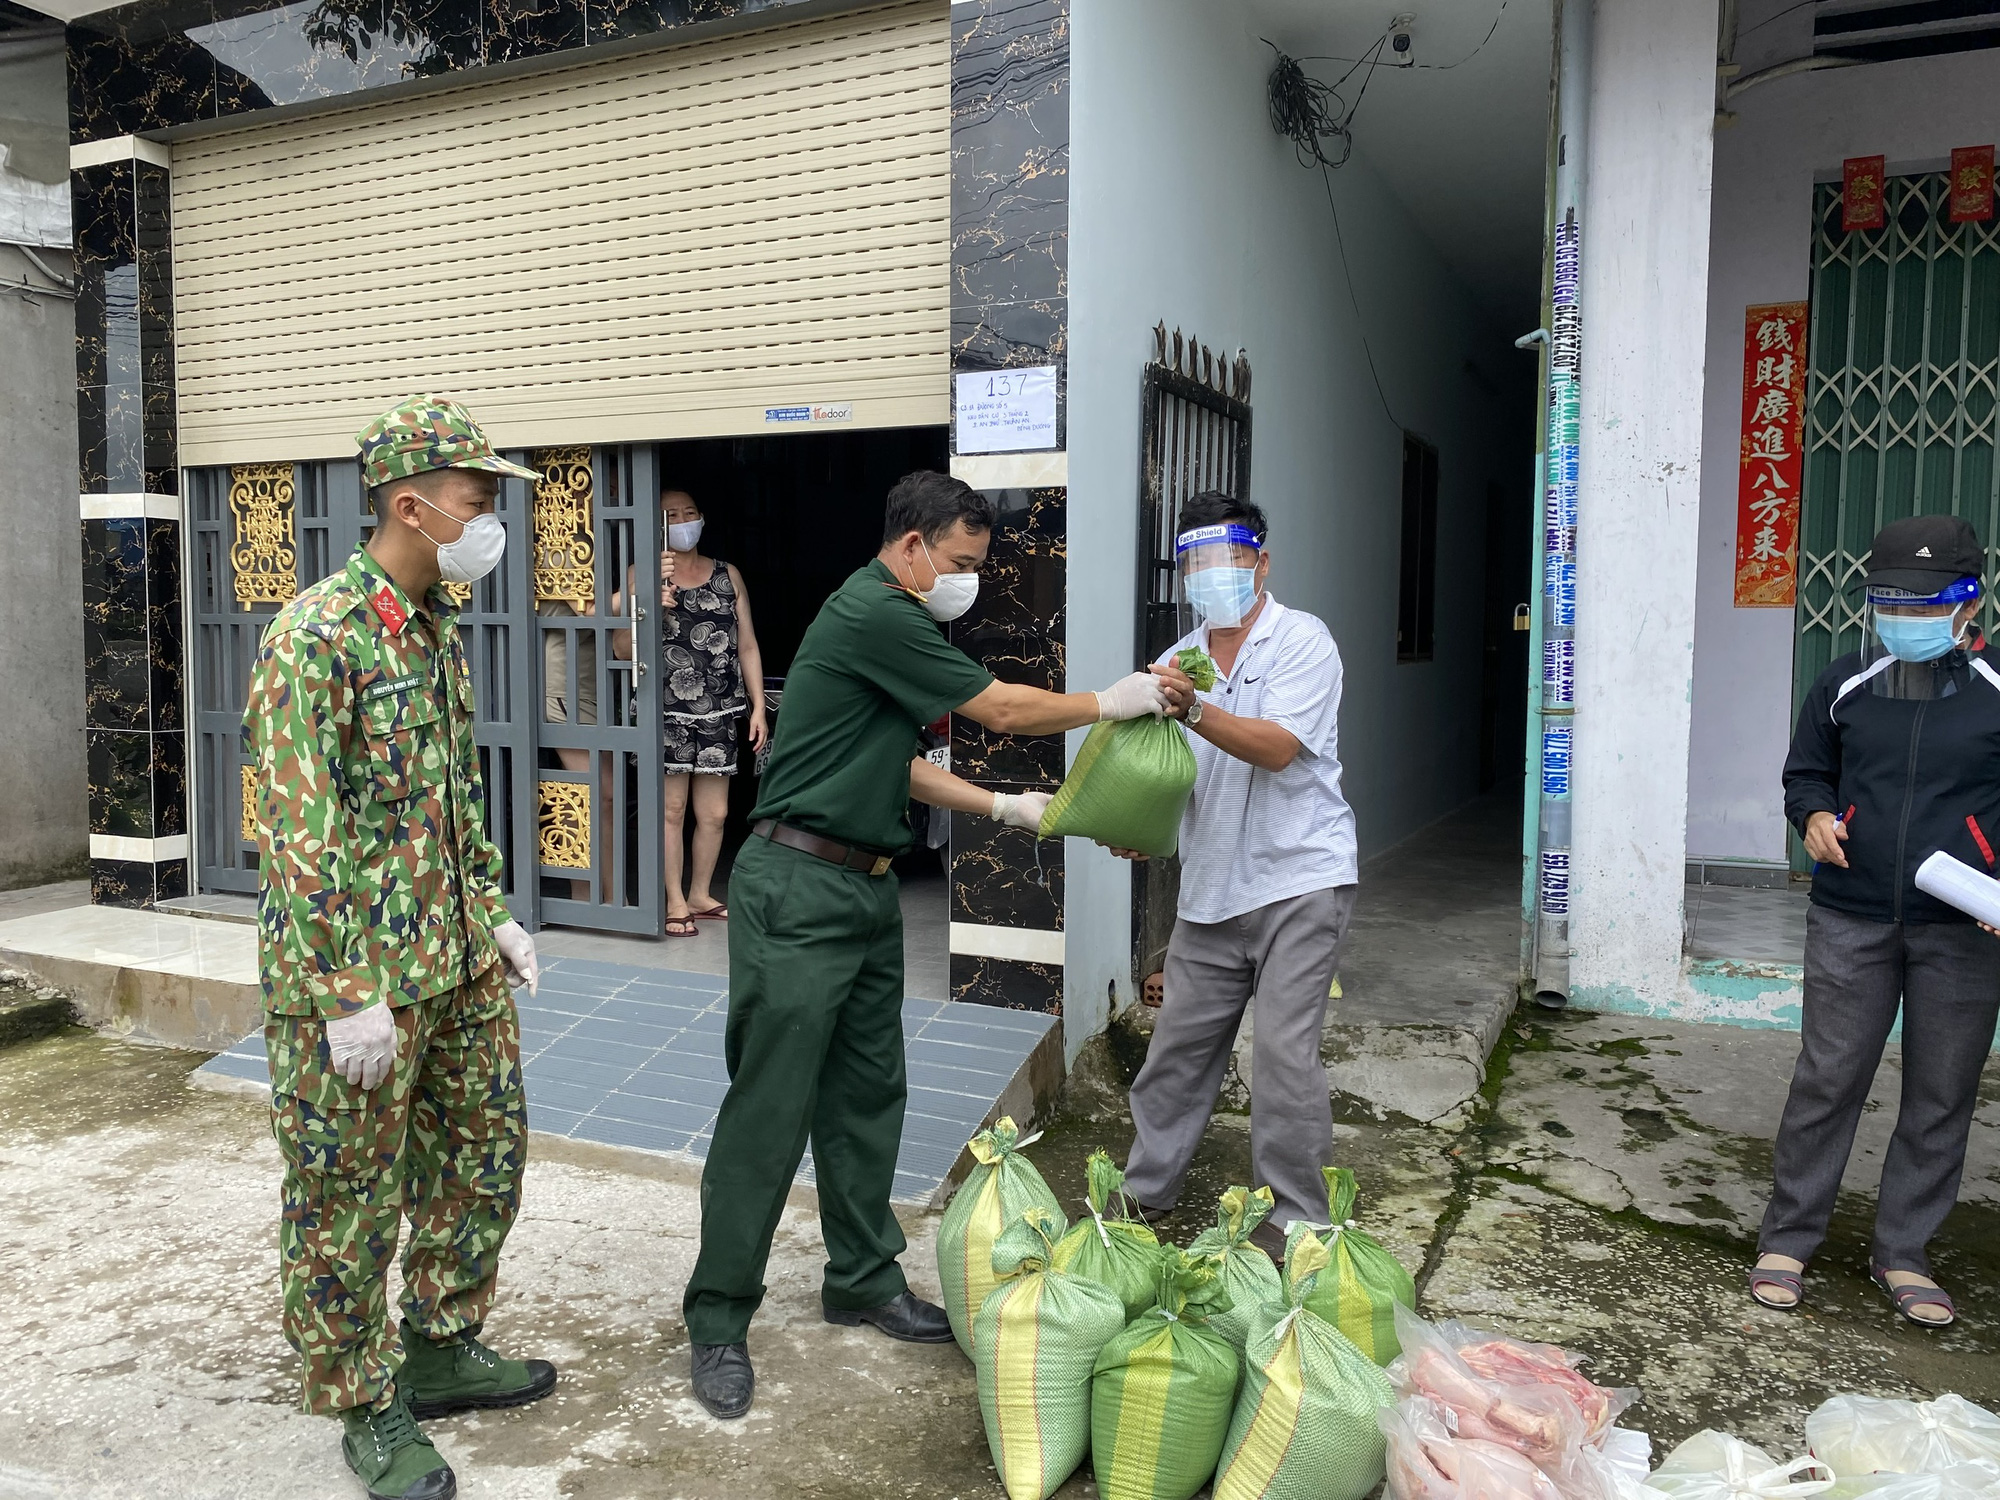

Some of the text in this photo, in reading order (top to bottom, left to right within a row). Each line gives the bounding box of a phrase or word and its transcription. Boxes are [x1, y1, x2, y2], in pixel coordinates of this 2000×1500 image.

[985, 373, 1028, 397] 137
[1180, 533, 1194, 544] Face
[1195, 527, 1223, 538] Shield
[1871, 587, 1891, 597] Face
[1542, 733, 1569, 795] 0961.005.778
[1542, 854, 1569, 915] 0976.627.155
